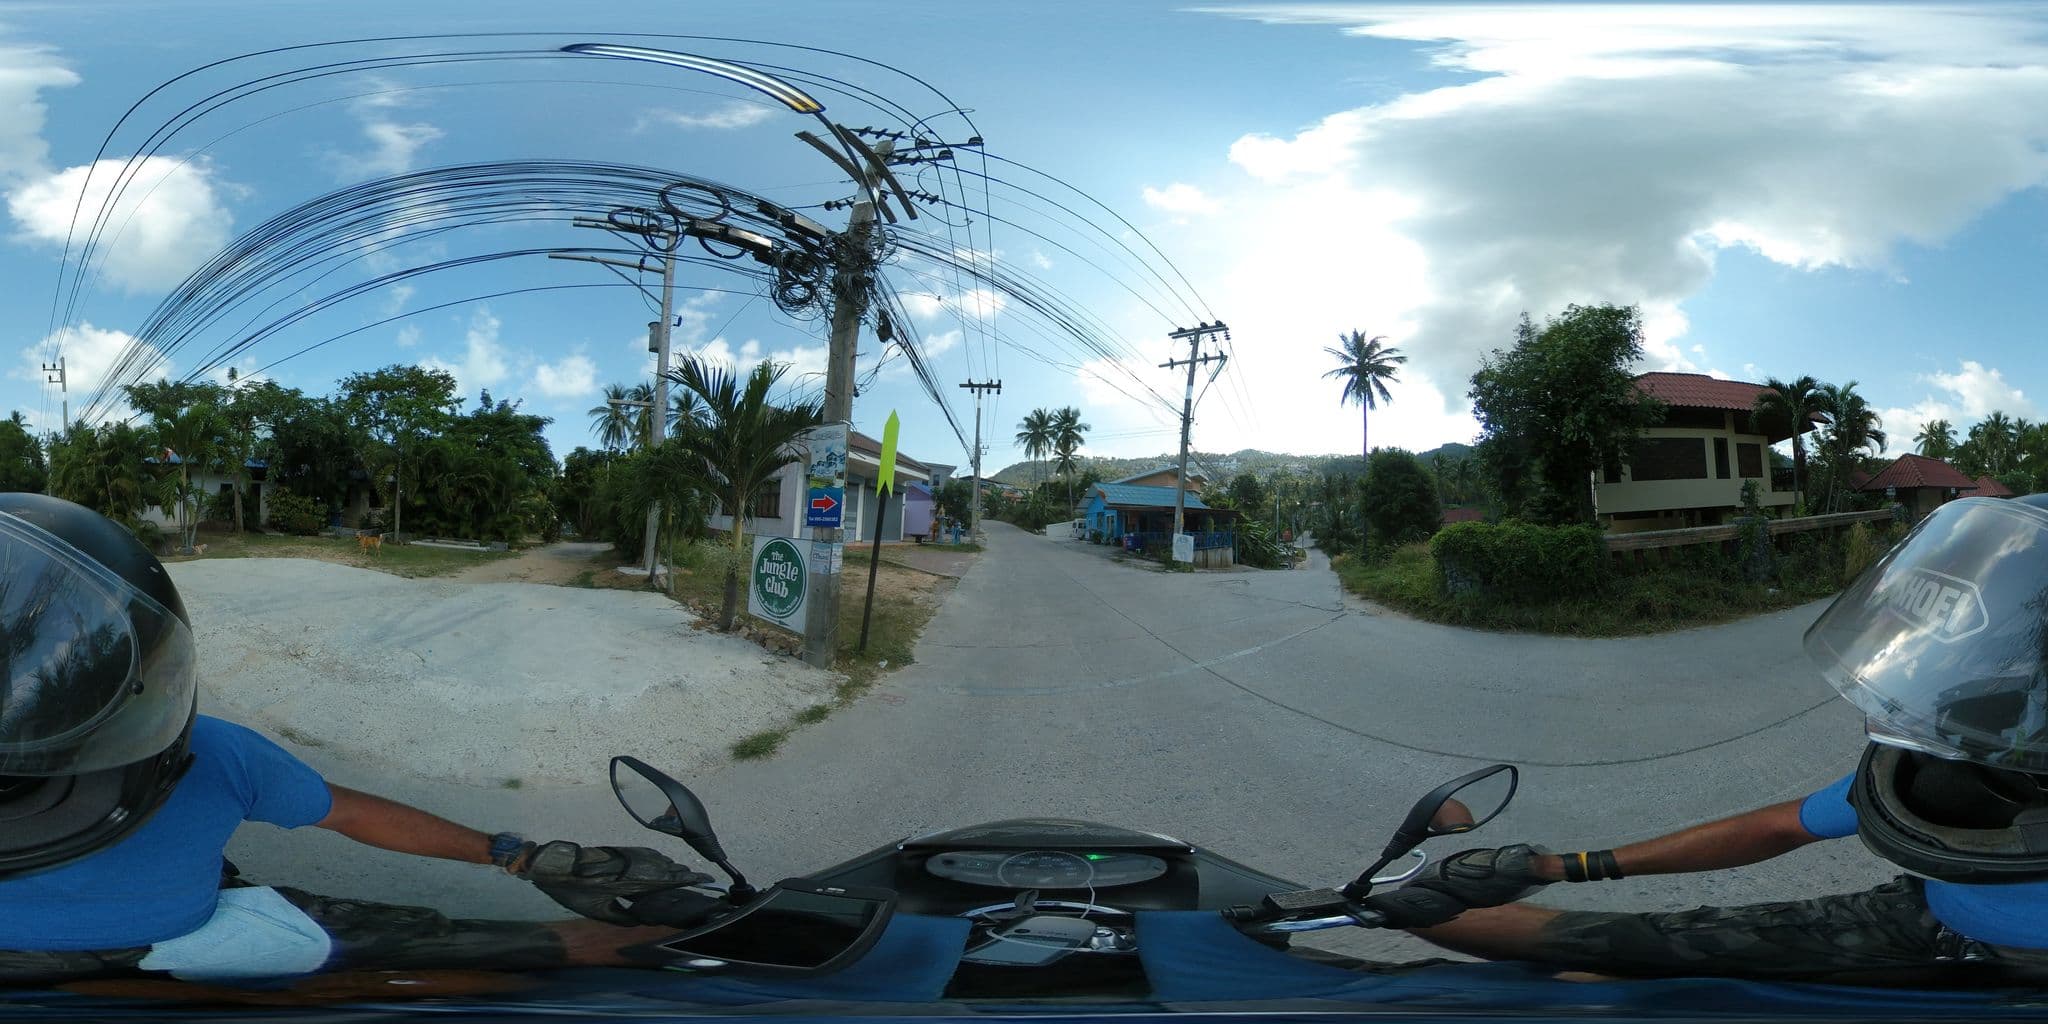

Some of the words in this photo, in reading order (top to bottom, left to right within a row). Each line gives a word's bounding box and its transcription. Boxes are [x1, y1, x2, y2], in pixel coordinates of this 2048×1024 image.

[771, 551, 784, 561] The
[760, 558, 799, 582] Jungle
[765, 576, 789, 598] Club
